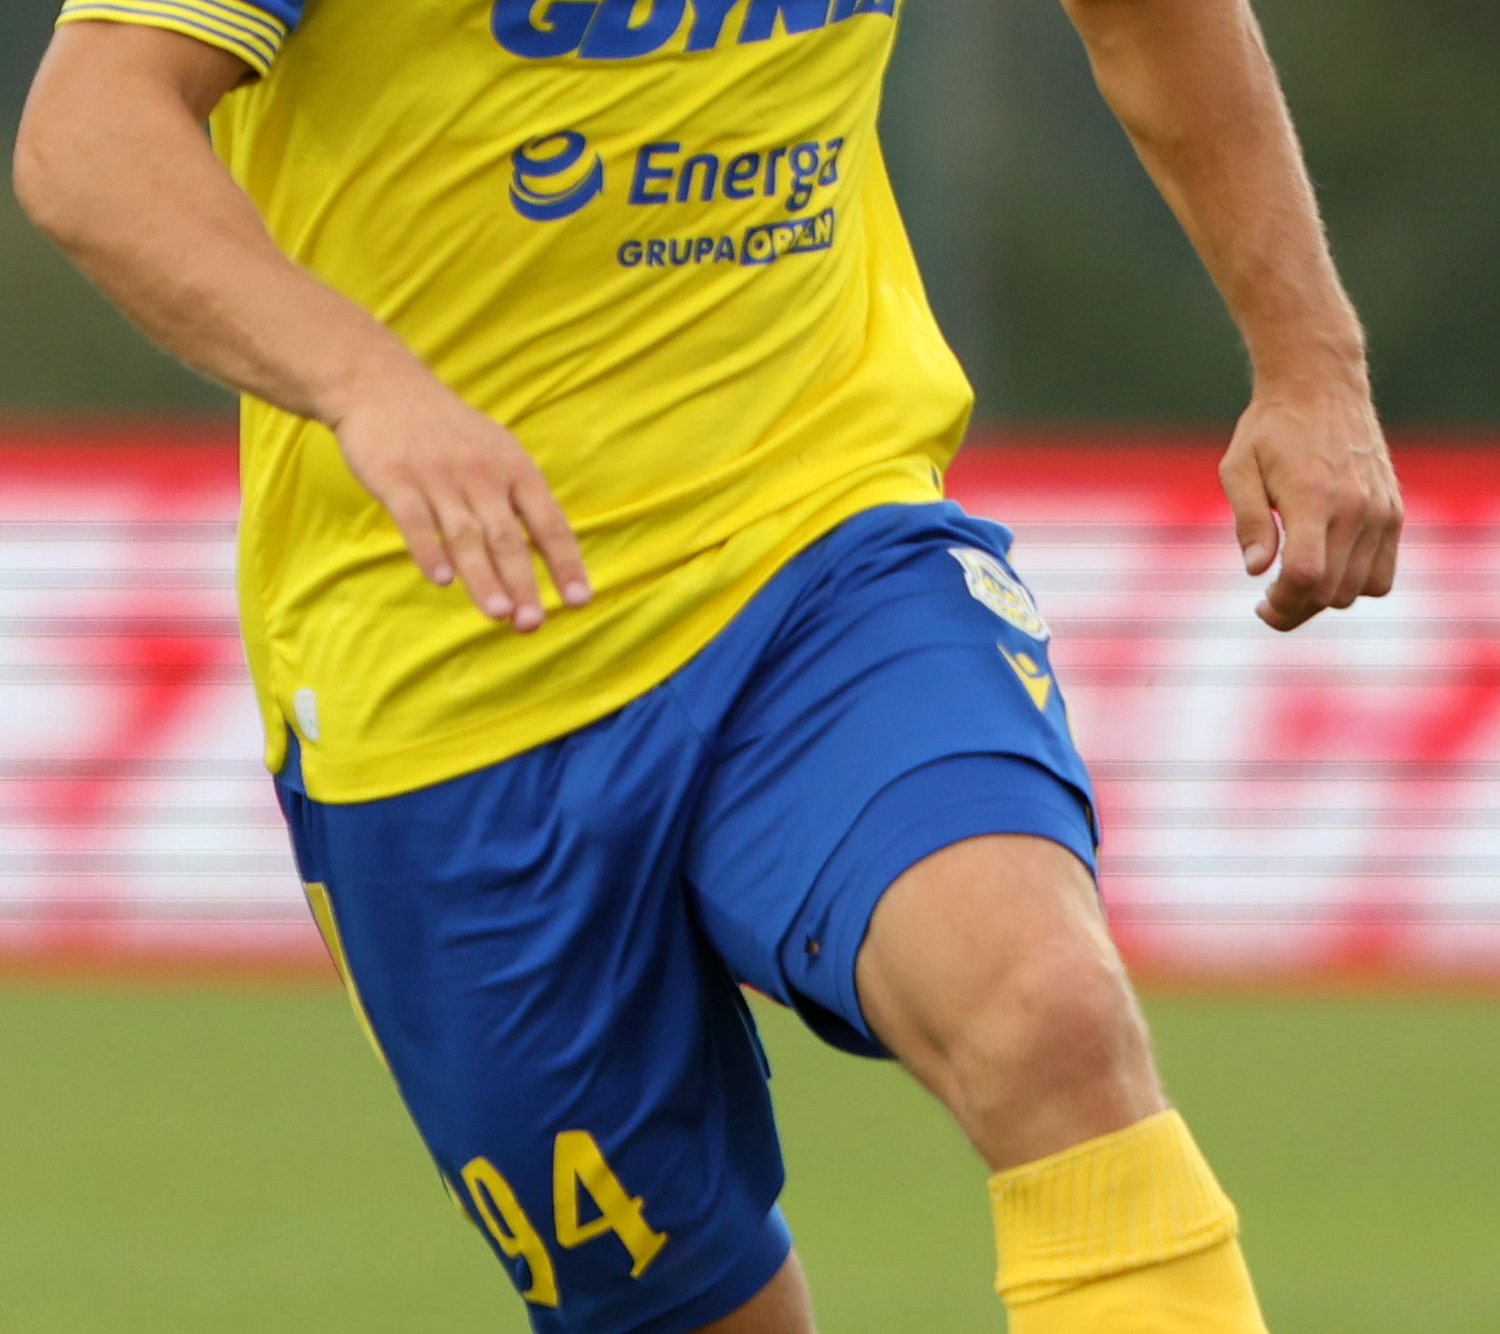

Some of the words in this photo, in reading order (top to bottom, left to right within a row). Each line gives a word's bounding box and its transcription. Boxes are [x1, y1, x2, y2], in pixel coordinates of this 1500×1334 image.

[627, 136, 844, 213] Energa
[616, 235, 736, 268] GRUPA
[460, 1129, 668, 1308] 94
